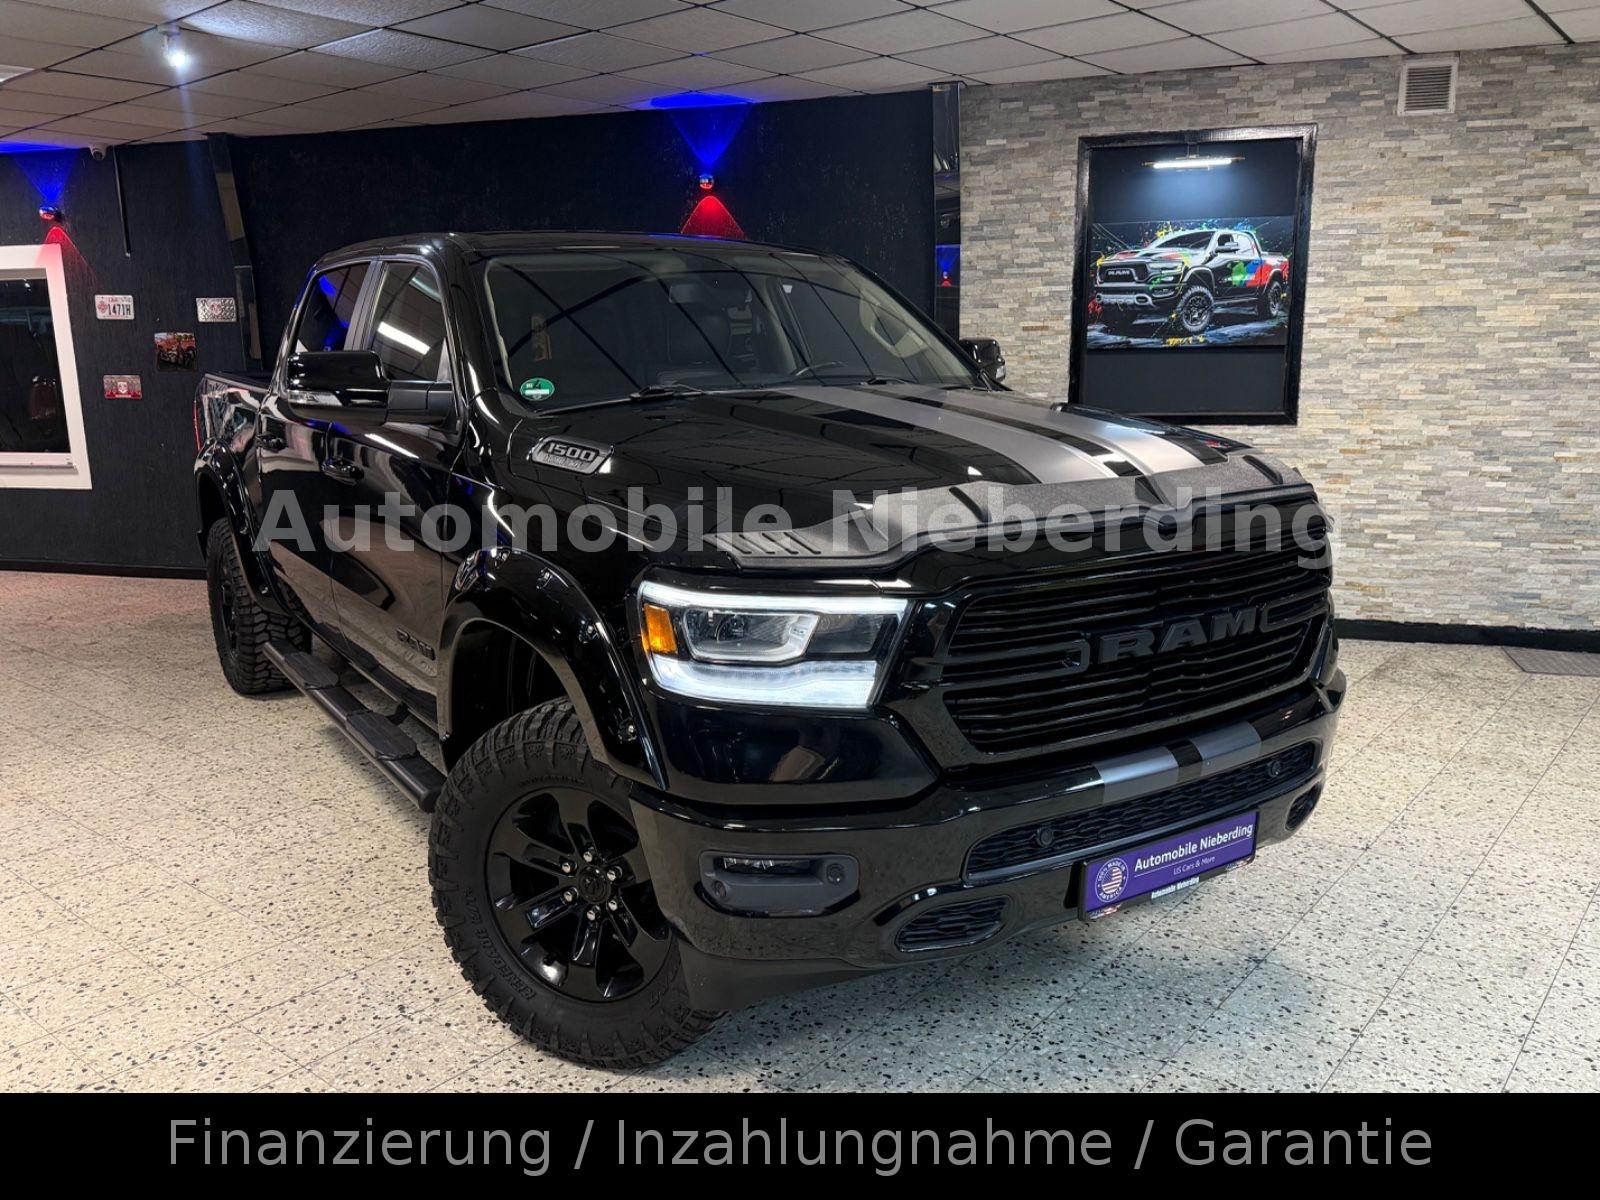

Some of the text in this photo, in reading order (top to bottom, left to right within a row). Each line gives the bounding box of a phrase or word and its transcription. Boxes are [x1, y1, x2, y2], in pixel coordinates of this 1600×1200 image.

[548, 442, 596, 462] 1500
[1098, 605, 1258, 664] RAM
[1134, 824, 1253, 872] Automobile Nieberding
[1174, 865, 1182, 875] US
[1182, 862, 1195, 874] Cars
[1201, 855, 1216, 867] More
[1098, 886, 1123, 900] AMERICA
